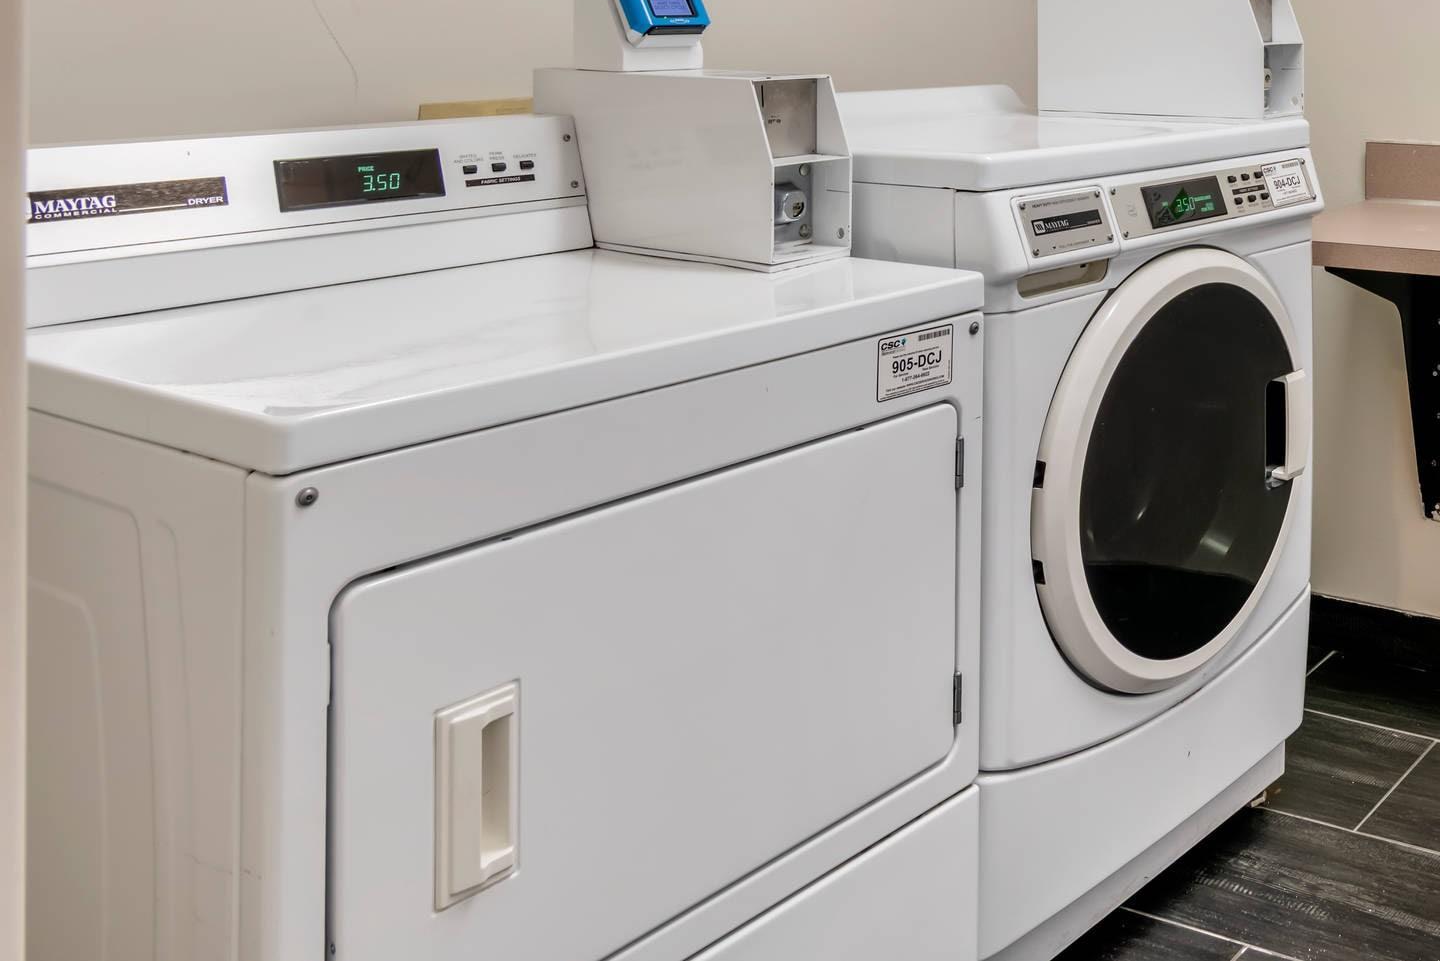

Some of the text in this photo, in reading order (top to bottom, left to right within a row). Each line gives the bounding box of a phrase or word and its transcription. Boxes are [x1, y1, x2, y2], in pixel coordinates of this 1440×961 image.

[363, 173, 400, 192] 3.50
[33, 195, 117, 215] MAYTAG
[187, 196, 224, 206] DRYER
[34, 208, 118, 220] COMMERCIAL
[880, 339, 901, 351] CSC
[892, 350, 942, 374] 905-DCJ
